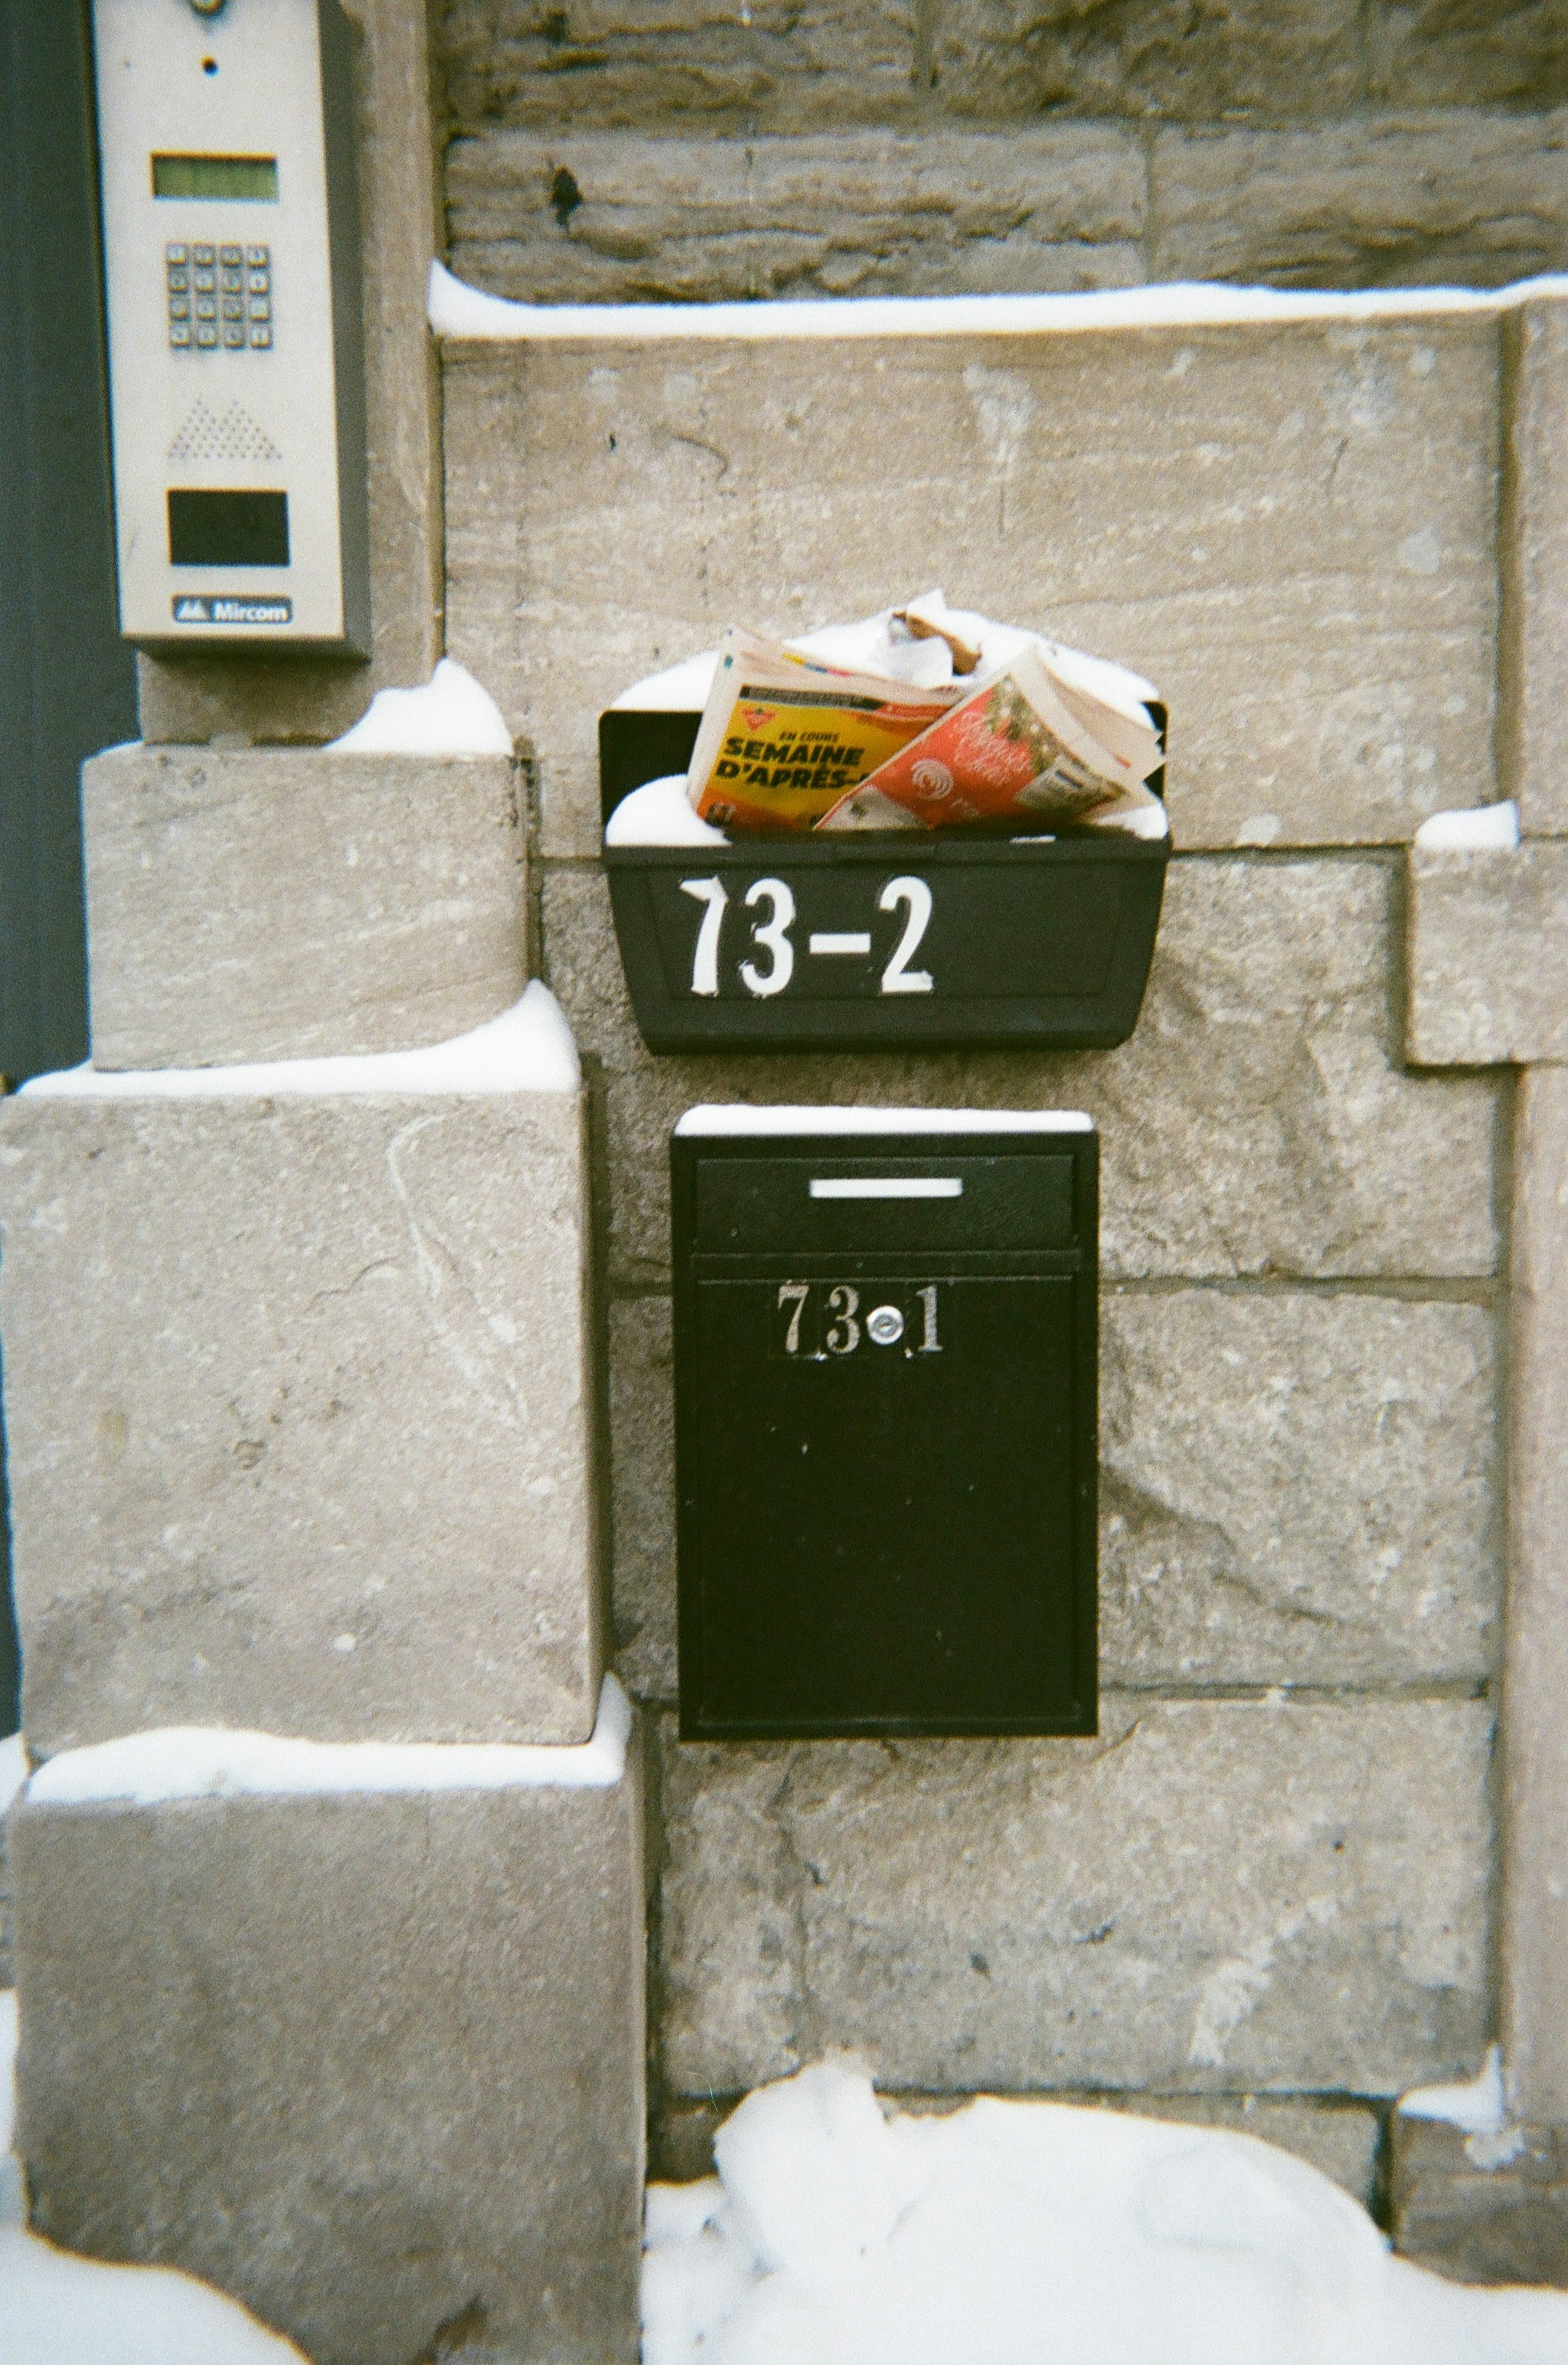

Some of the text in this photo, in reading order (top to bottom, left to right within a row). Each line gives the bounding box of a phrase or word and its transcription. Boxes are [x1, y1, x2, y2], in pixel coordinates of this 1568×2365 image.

[214, 601, 289, 621] Mircom
[779, 731, 798, 741] EN
[724, 737, 865, 766] SEMAINE
[679, 876, 933, 998] 73-2
